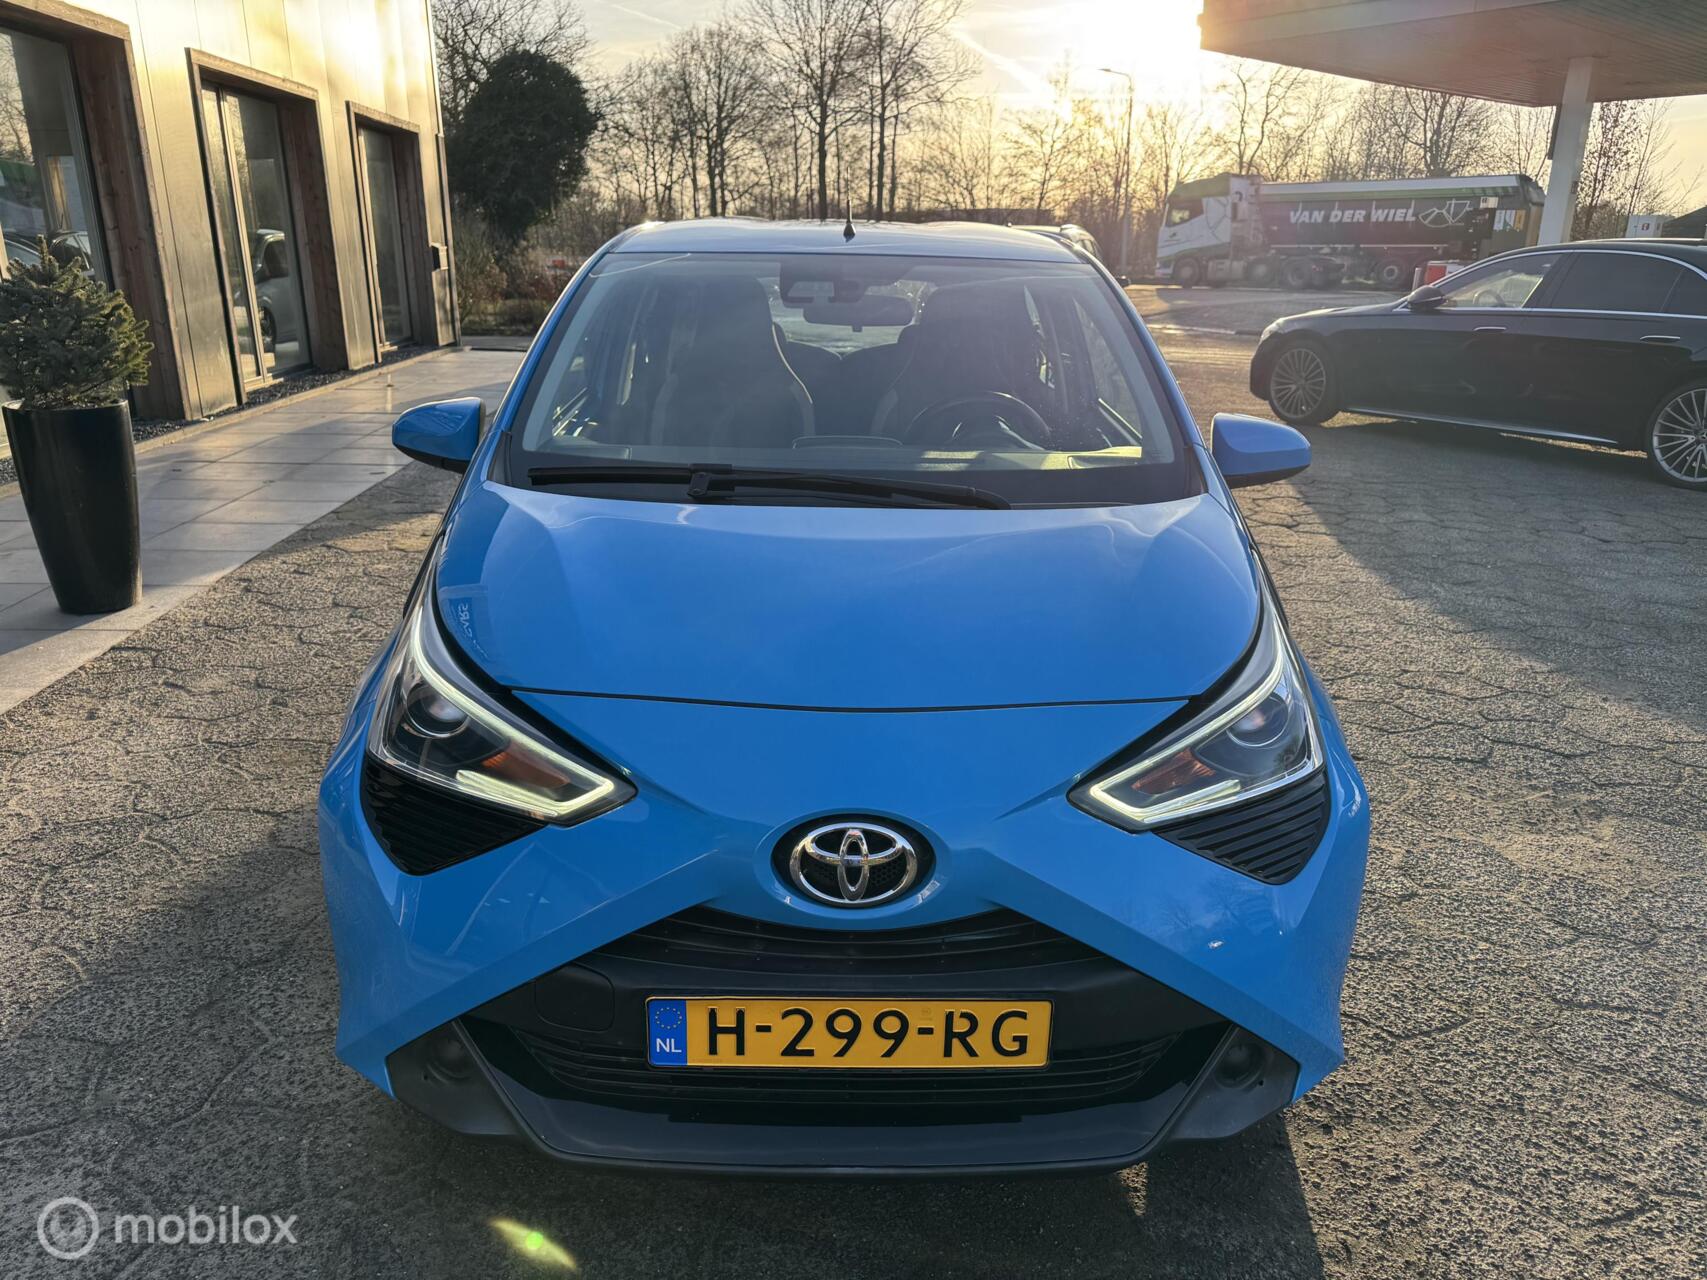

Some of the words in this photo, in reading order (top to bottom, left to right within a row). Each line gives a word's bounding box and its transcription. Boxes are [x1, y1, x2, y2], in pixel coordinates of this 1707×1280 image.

[1290, 202, 1325, 223] VAN
[1329, 202, 1366, 223] DER
[1370, 200, 1417, 222] WIEL
[656, 1037, 682, 1053] NL
[707, 1006, 1030, 1058] H-299-RG
